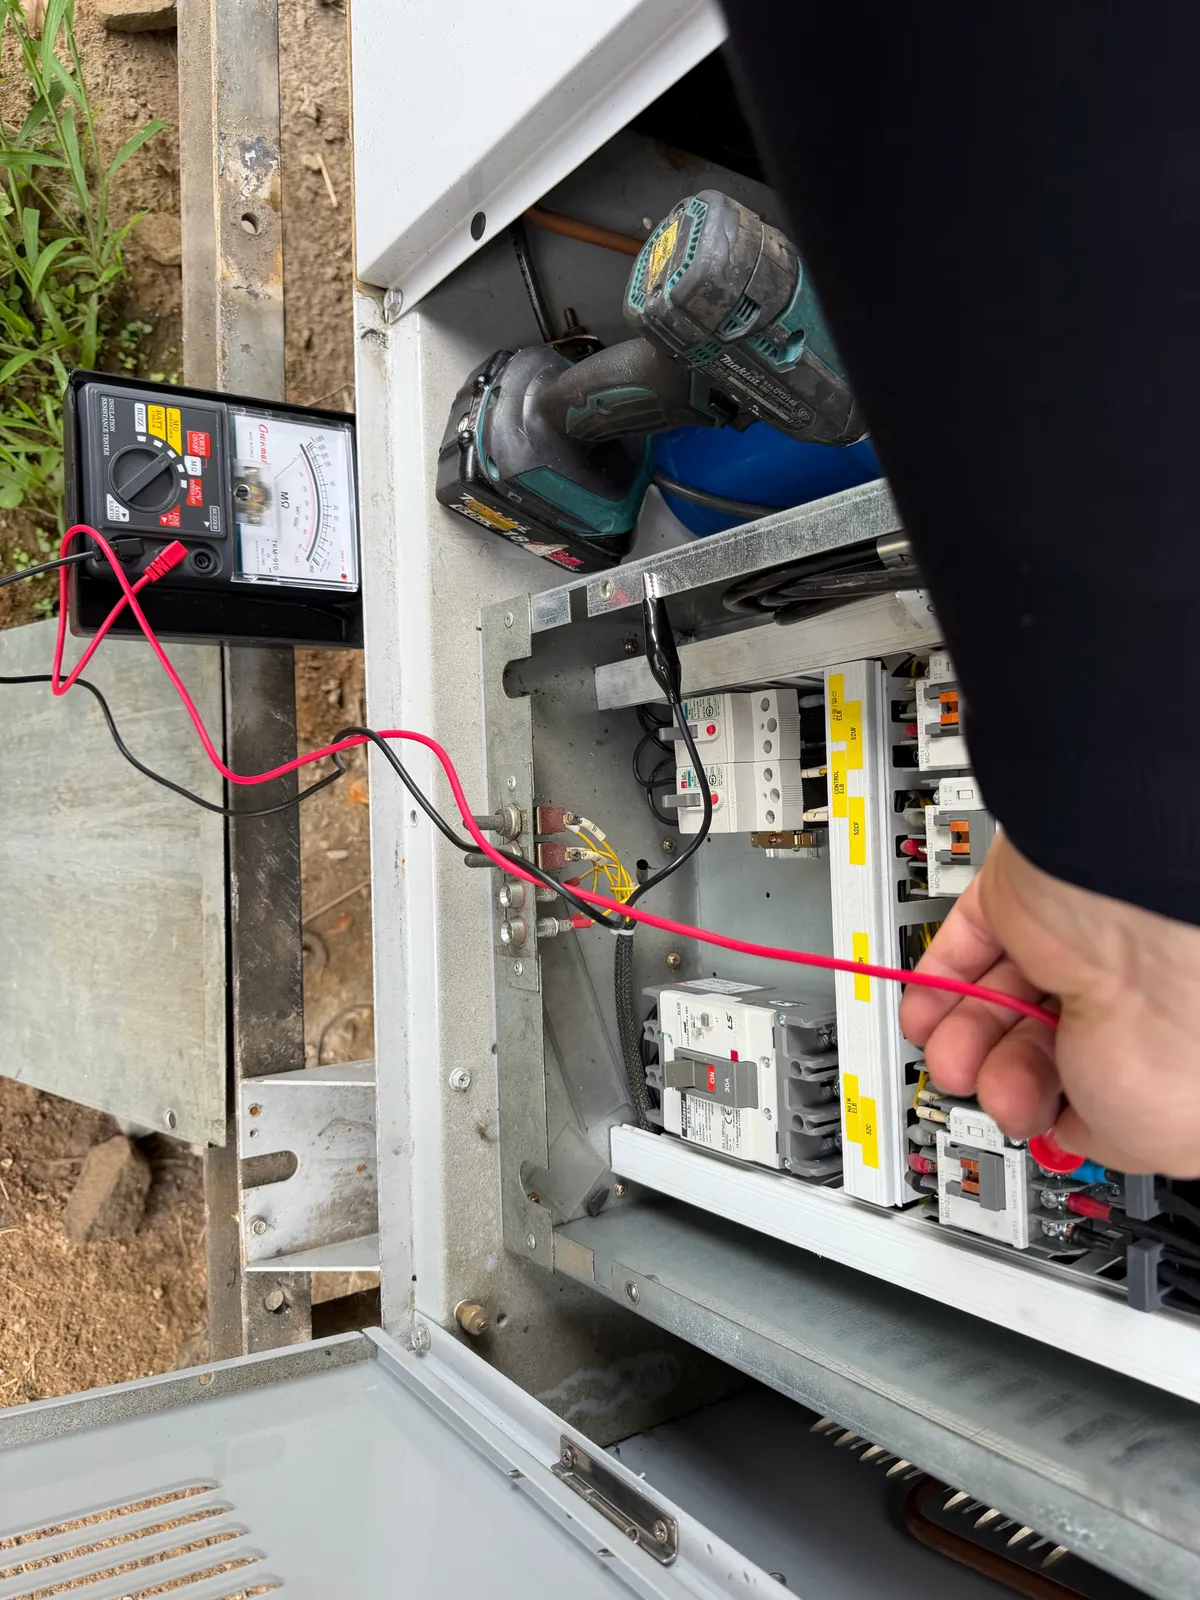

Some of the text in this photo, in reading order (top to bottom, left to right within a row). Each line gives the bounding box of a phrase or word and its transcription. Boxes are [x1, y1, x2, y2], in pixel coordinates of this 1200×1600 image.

[280, 491, 290, 509] MΩ
[727, 1014, 733, 1030] LS
[709, 1071, 715, 1085] ON
